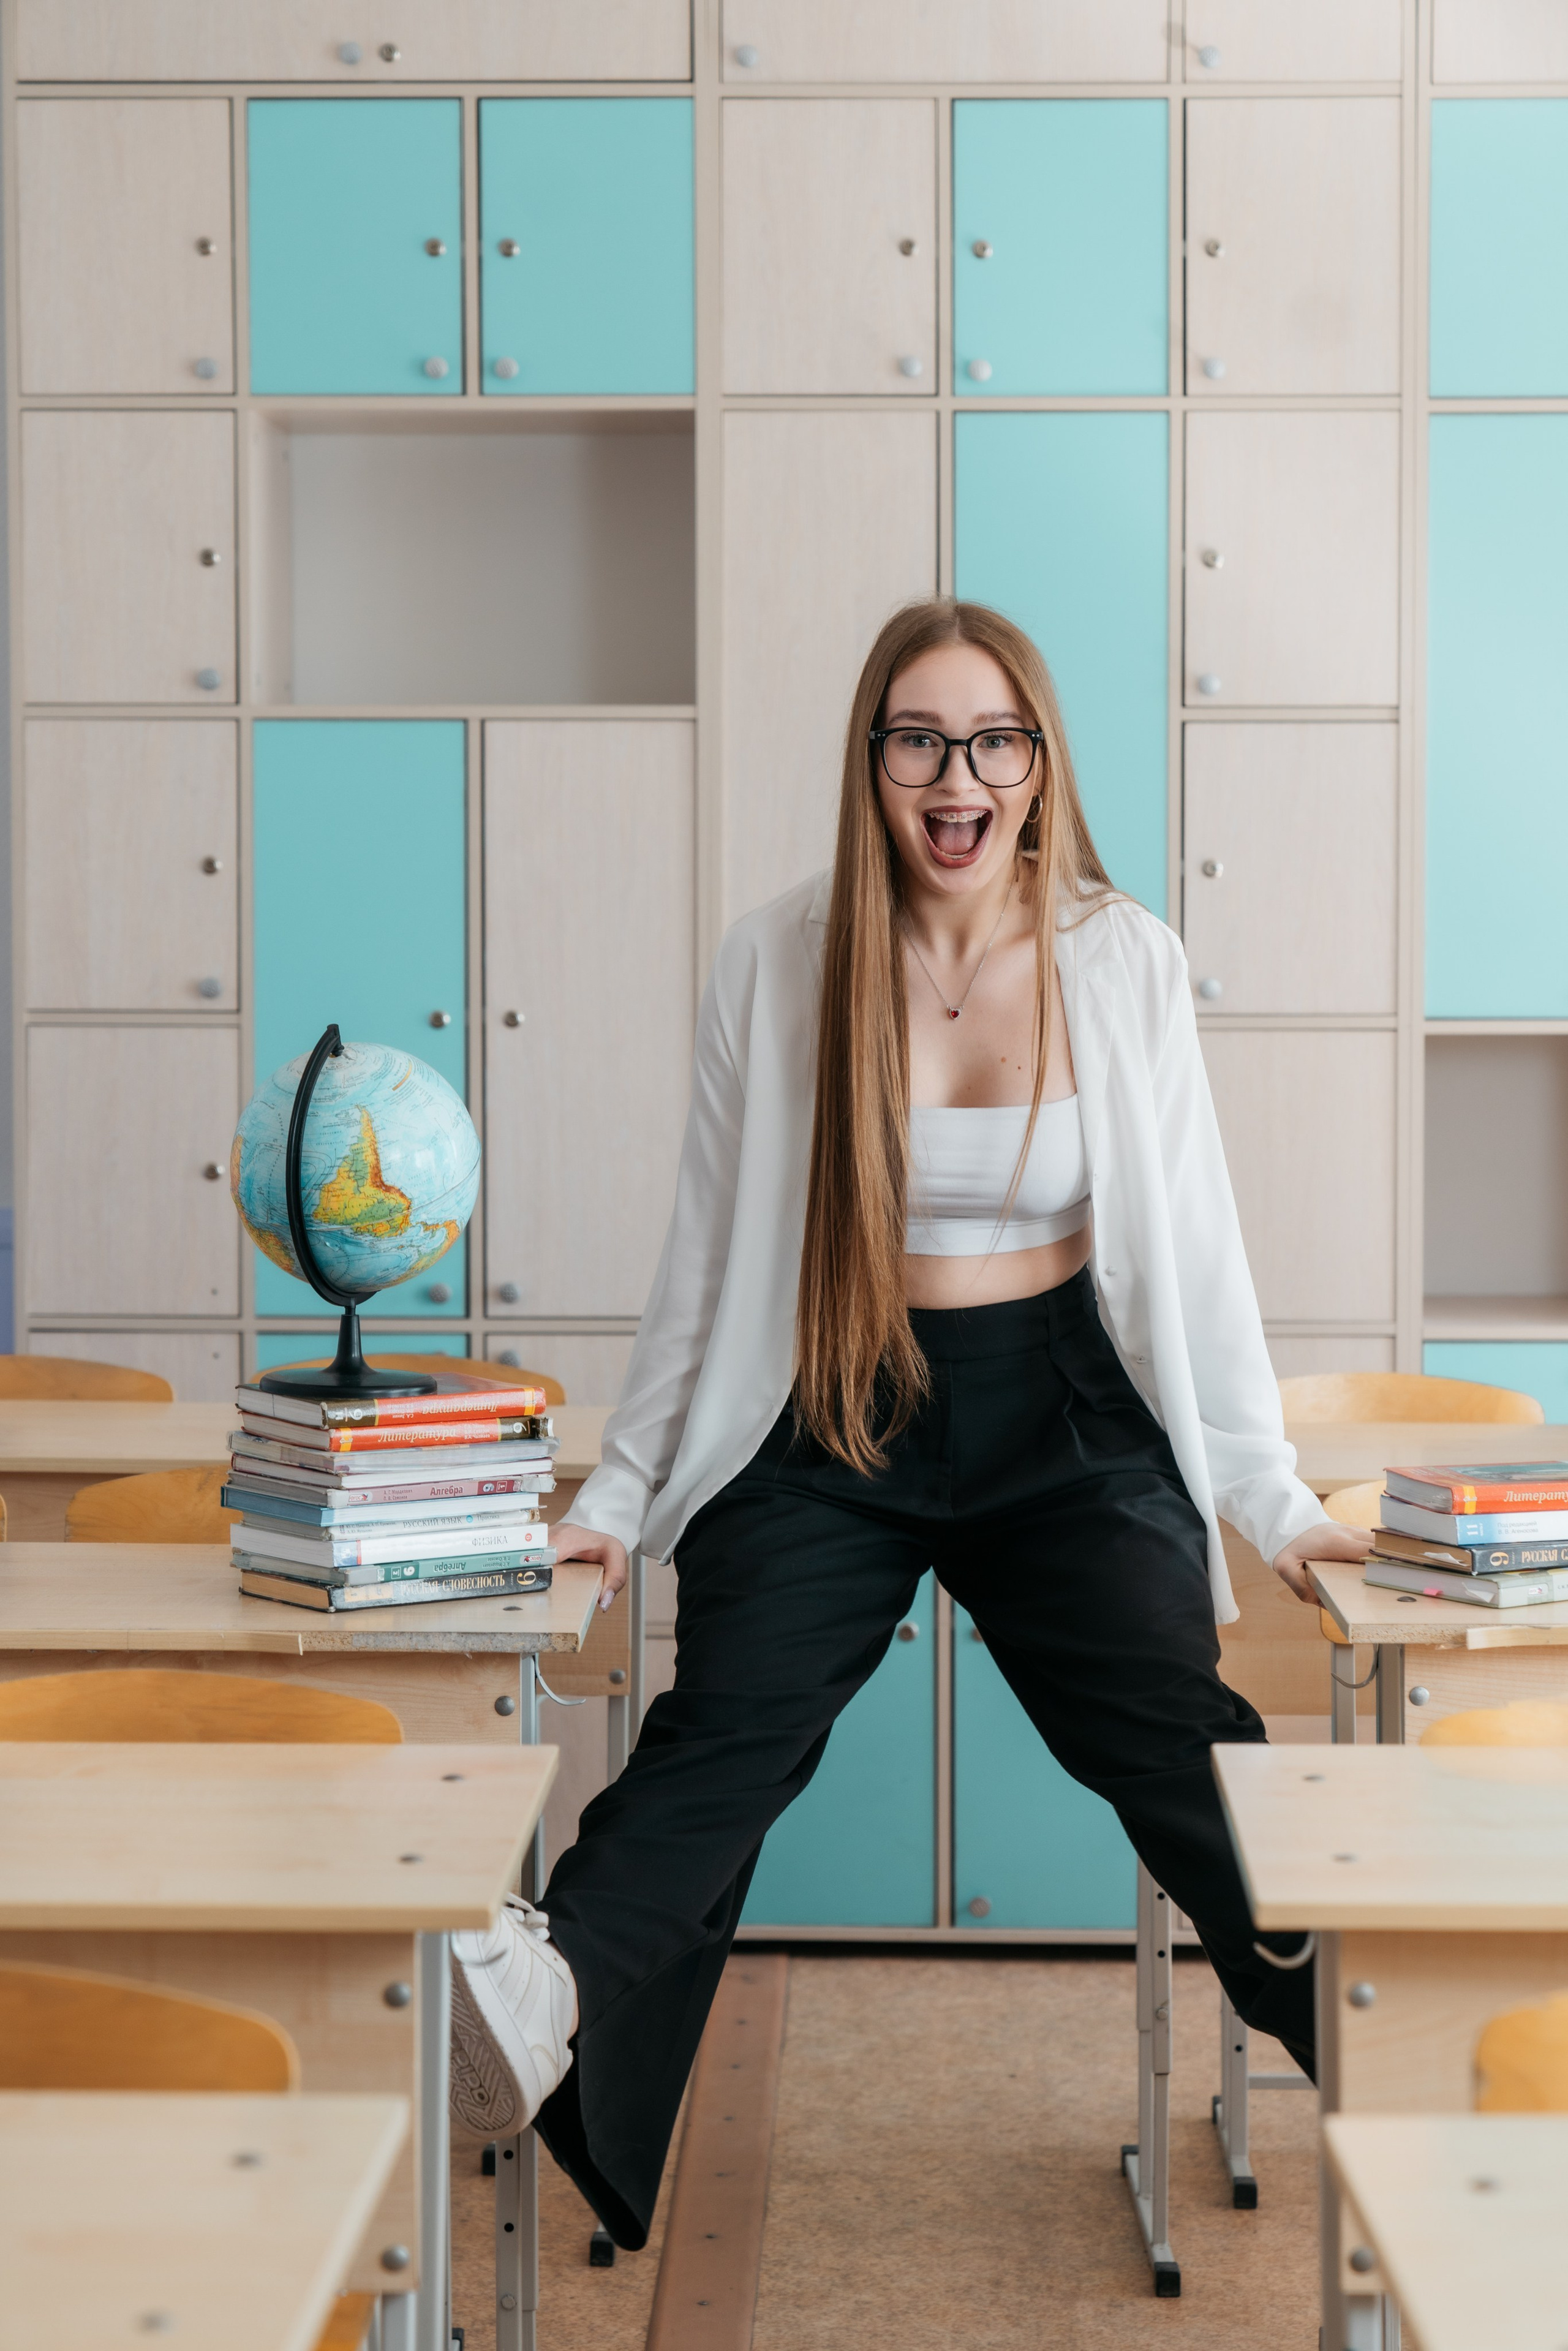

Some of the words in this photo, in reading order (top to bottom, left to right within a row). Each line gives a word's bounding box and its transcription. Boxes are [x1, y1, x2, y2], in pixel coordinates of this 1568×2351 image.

[421, 1401, 500, 1414] Литература
[377, 1428, 456, 1443] Литература
[430, 1485, 463, 1496] Алгебра
[402, 1517, 439, 1528] РУССКИЙ
[441, 1516, 462, 1525] ЯЗЫК
[477, 1514, 500, 1522] Практика
[1466, 1524, 1479, 1536] 11
[471, 1535, 508, 1547] ФИЗИКА
[1521, 1549, 1558, 1563] РУССКАЯ
[434, 1561, 466, 1573] Алгебра
[442, 1574, 505, 1593] СЛОВЕСНОСТЬ
